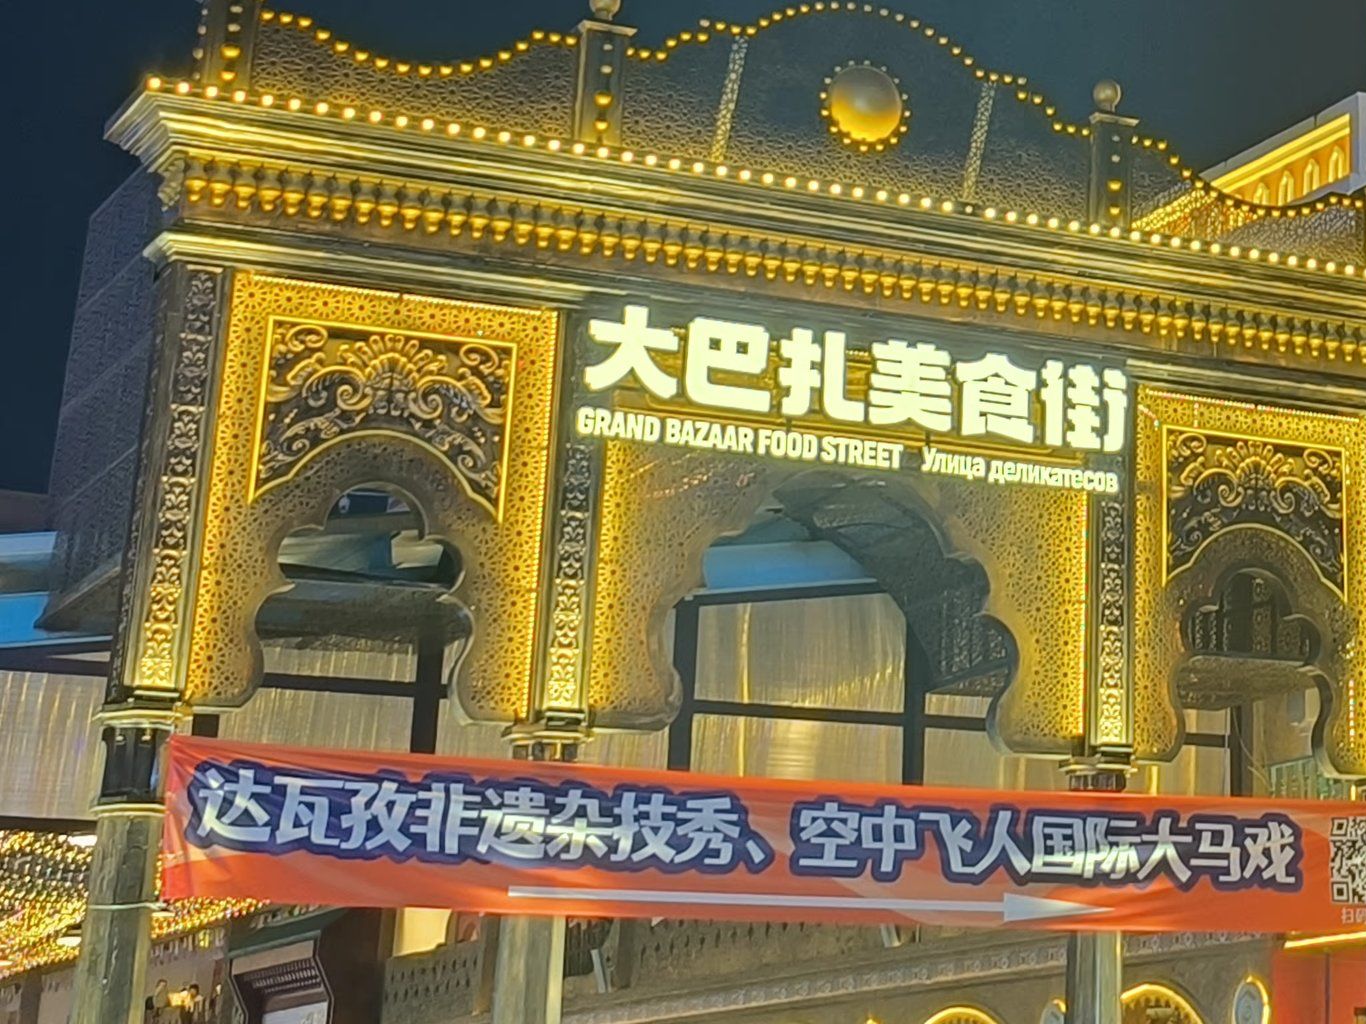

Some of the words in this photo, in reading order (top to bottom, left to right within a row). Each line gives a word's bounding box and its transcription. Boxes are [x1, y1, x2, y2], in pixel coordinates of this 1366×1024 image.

[584, 305, 1127, 453] 大巴扎美食街
[577, 407, 661, 443] GRAND
[665, 417, 754, 454] BAZAAR
[757, 428, 818, 460] FOOD
[820, 435, 904, 470] STREET
[921, 446, 986, 479] Улица
[988, 459, 1120, 493] деликатесов
